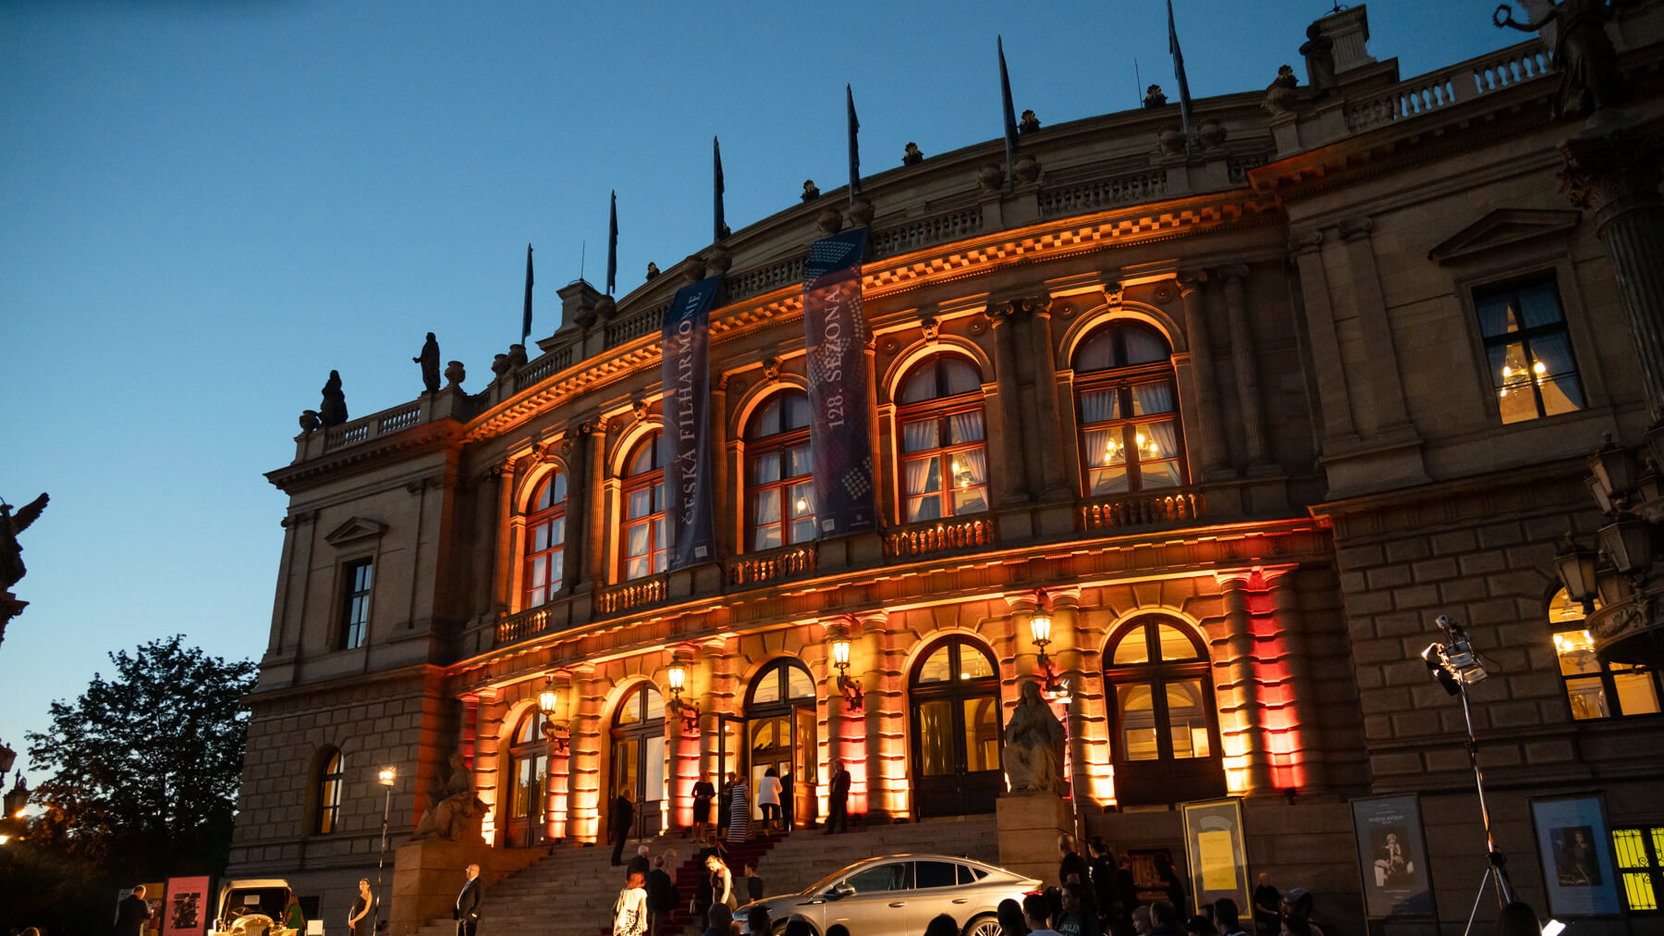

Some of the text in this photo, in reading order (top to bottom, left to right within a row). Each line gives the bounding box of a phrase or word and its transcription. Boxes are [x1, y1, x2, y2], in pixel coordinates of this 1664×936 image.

[678, 292, 702, 525] ČESKÁ FILHARMONIE
[824, 288, 844, 430] 128. SEZONA
